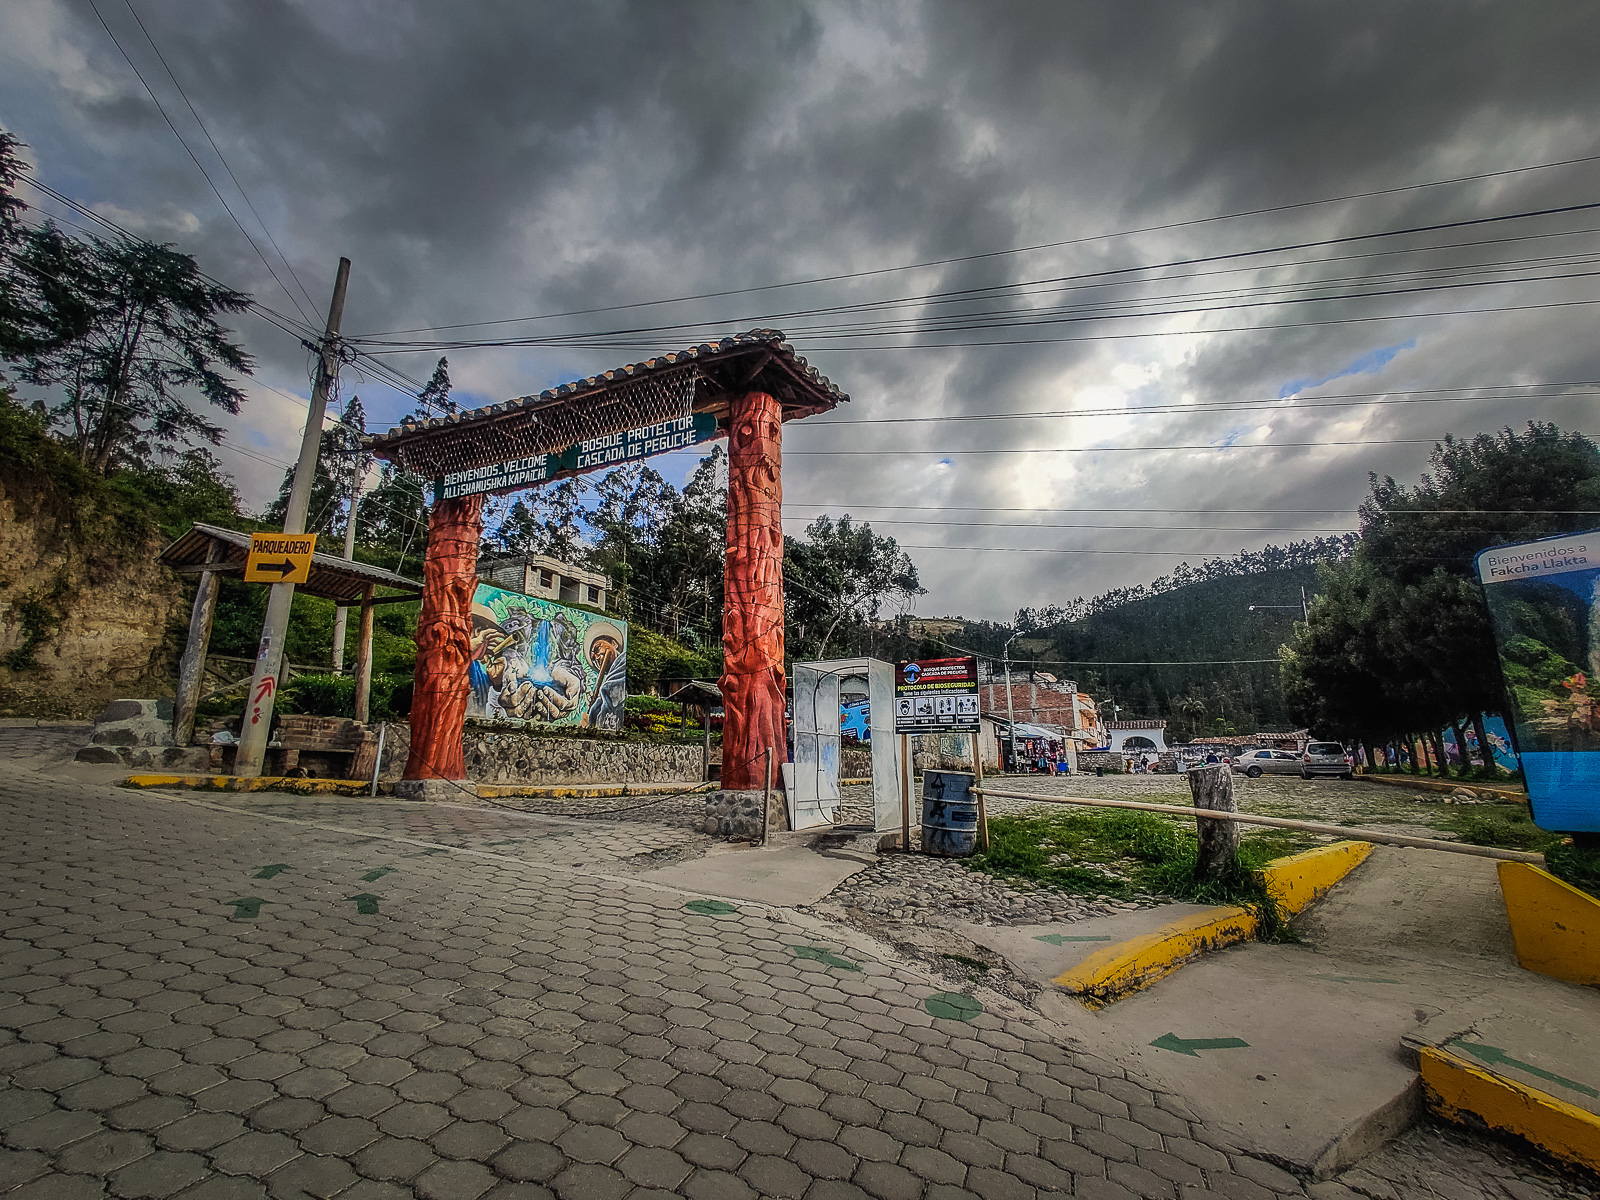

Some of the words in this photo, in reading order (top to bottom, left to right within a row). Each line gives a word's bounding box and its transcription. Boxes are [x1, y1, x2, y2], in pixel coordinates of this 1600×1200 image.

[627, 416, 694, 442] PROTECTOR
[576, 446, 625, 469] CASCADA
[627, 442, 642, 457] DE
[644, 429, 697, 454] PEGUCHE
[252, 540, 311, 555] PARQUEADERO
[1488, 546, 1575, 567] Bienvenidos
[1490, 563, 1539, 577] Fakcha
[1542, 556, 1588, 569] Llakta
